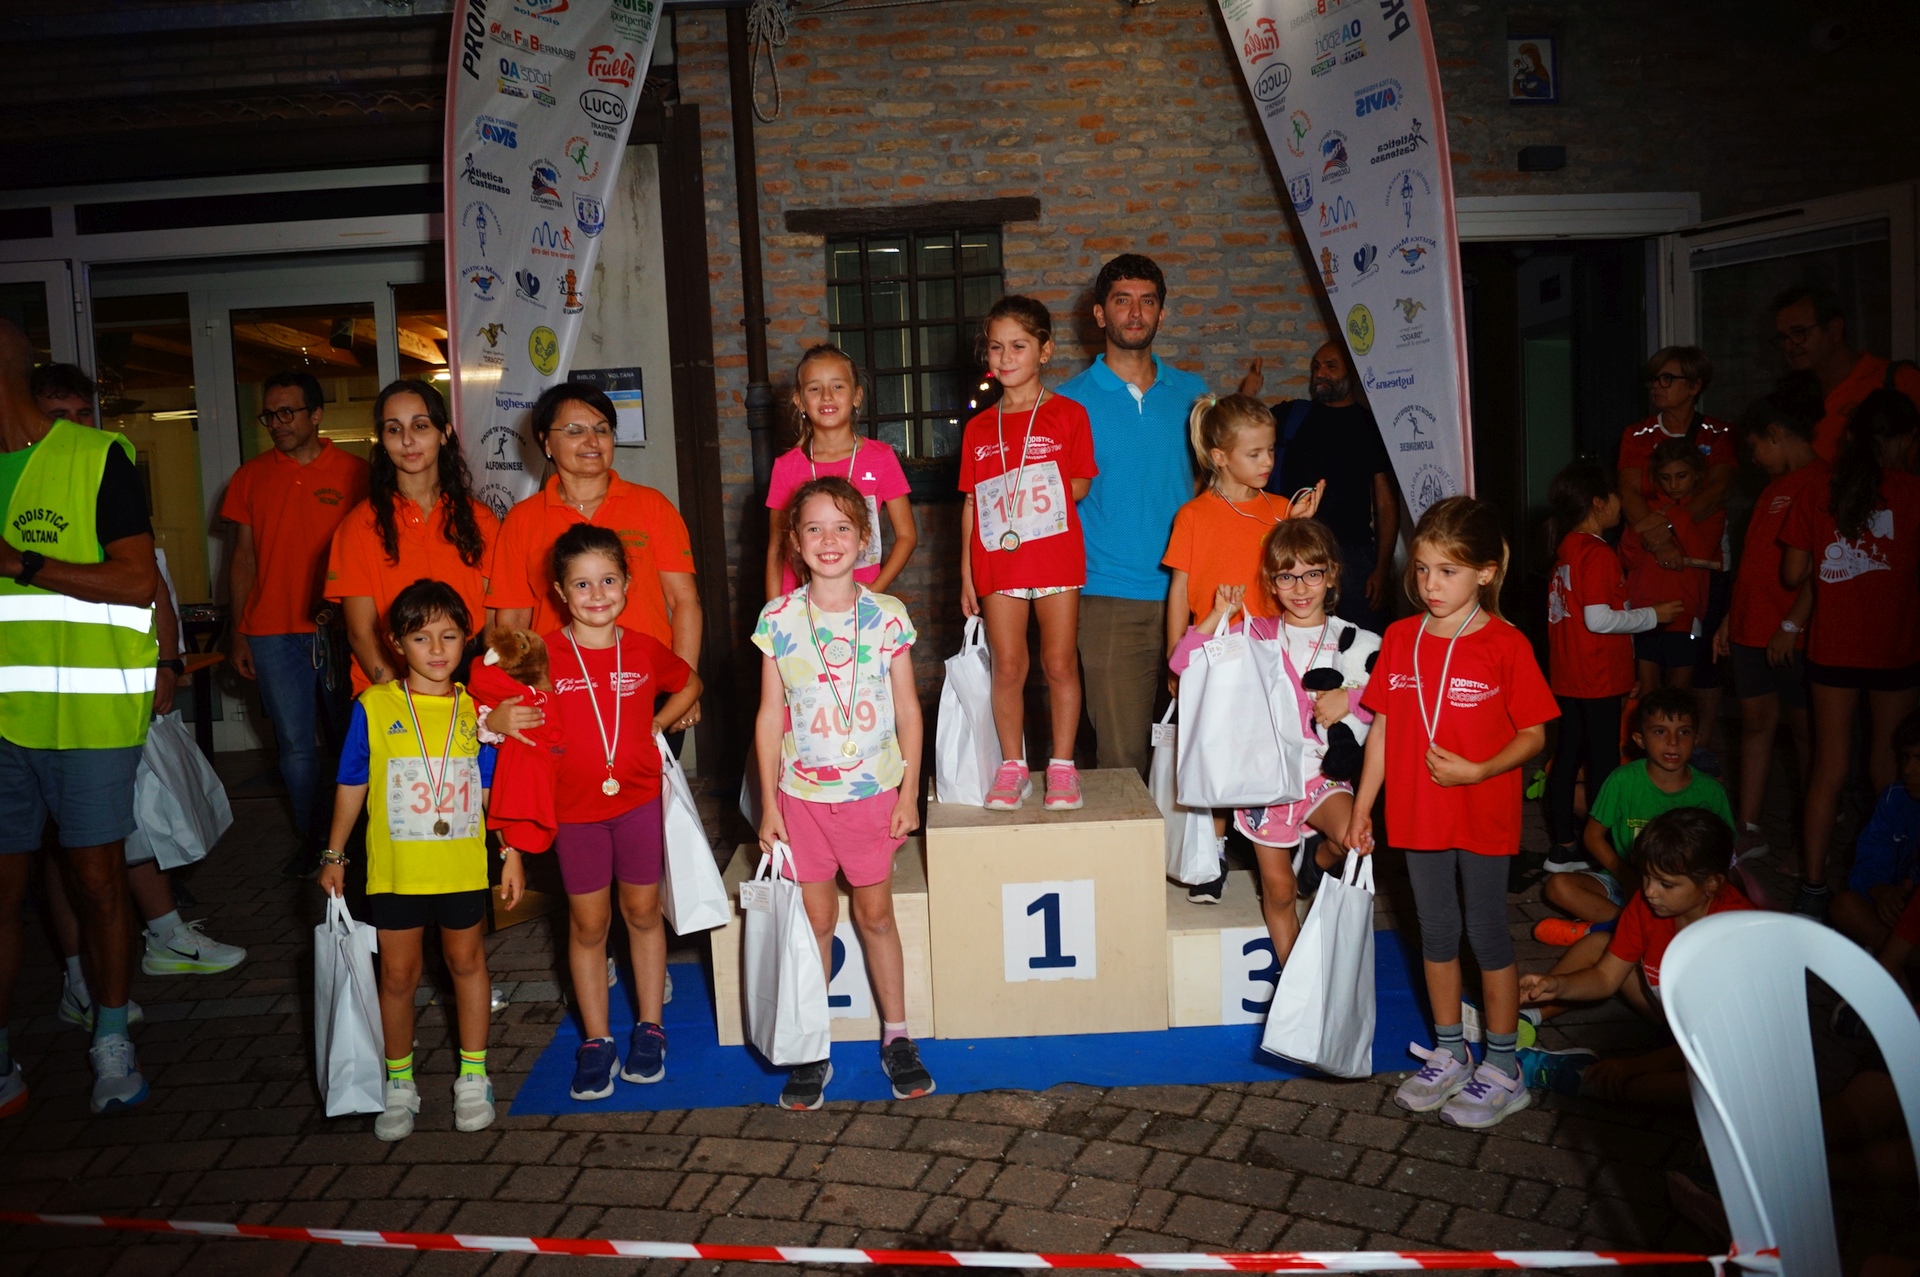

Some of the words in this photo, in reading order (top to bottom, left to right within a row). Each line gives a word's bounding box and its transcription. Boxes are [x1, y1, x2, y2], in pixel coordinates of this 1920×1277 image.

[513, 6, 560, 26] solarolo
[584, 96, 624, 119] LUCCI
[481, 123, 518, 149] AVIS
[591, 121, 618, 134] TRASPORTI
[593, 130, 616, 142] RAVENNA
[470, 167, 504, 184] Atletica
[577, 161, 599, 182] VOLTANA
[470, 176, 511, 195] Castenaso
[530, 195, 564, 208] LOCOMOTIVA
[531, 247, 541, 255] giro
[576, 373, 597, 381] BIBLIO
[500, 426, 527, 447] PODISTICA
[485, 461, 523, 471] ALFONSINESE
[993, 484, 1052, 524] 175
[12, 507, 70, 533] PODISTICA
[21, 529, 59, 544] VOLTANA
[1451, 677, 1489, 690] PODISTICA
[810, 700, 877, 739] 409
[411, 781, 470, 815] 321
[1027, 892, 1077, 970] 1
[1241, 937, 1282, 1014] 3
